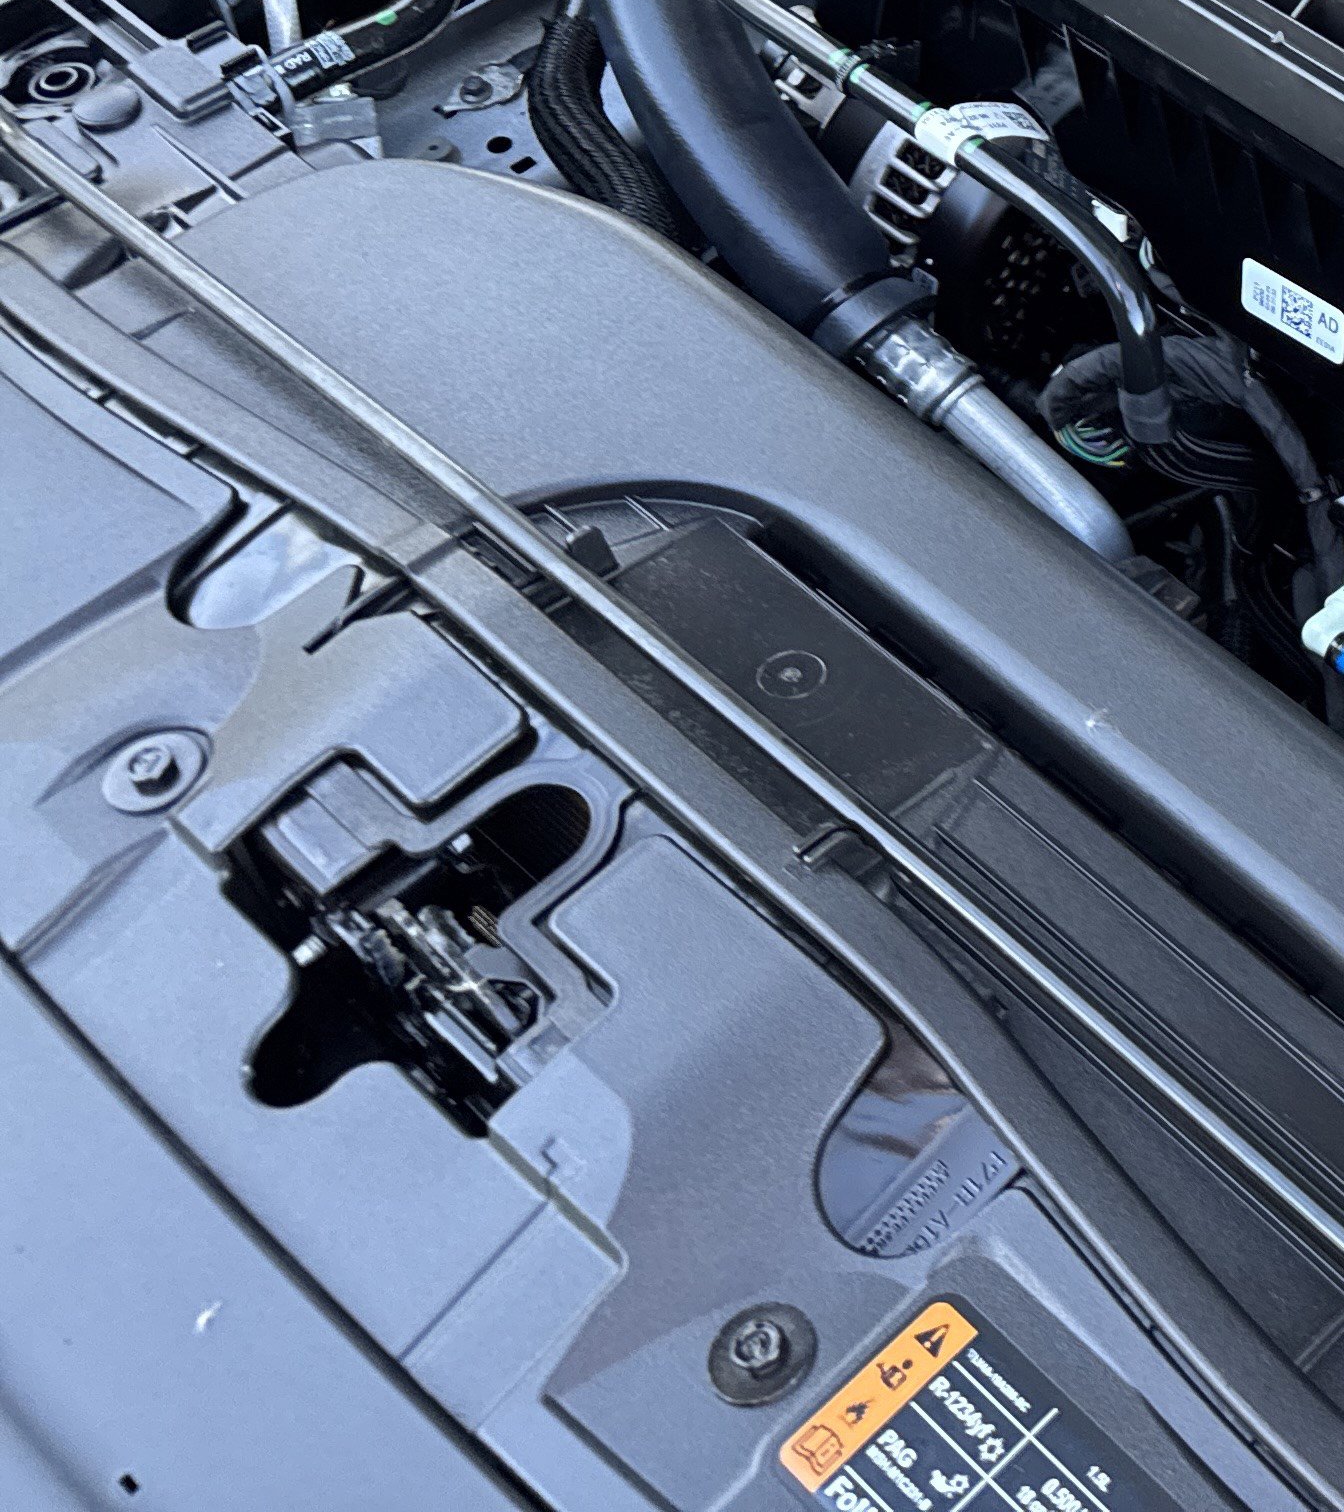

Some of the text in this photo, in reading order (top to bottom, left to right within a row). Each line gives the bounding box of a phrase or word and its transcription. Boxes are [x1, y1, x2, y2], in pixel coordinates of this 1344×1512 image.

[282, 50, 312, 69] RAD
[1319, 311, 1338, 335] AD
[927, 1374, 997, 1440] R-1234yf
[875, 1426, 920, 1471] PAG
